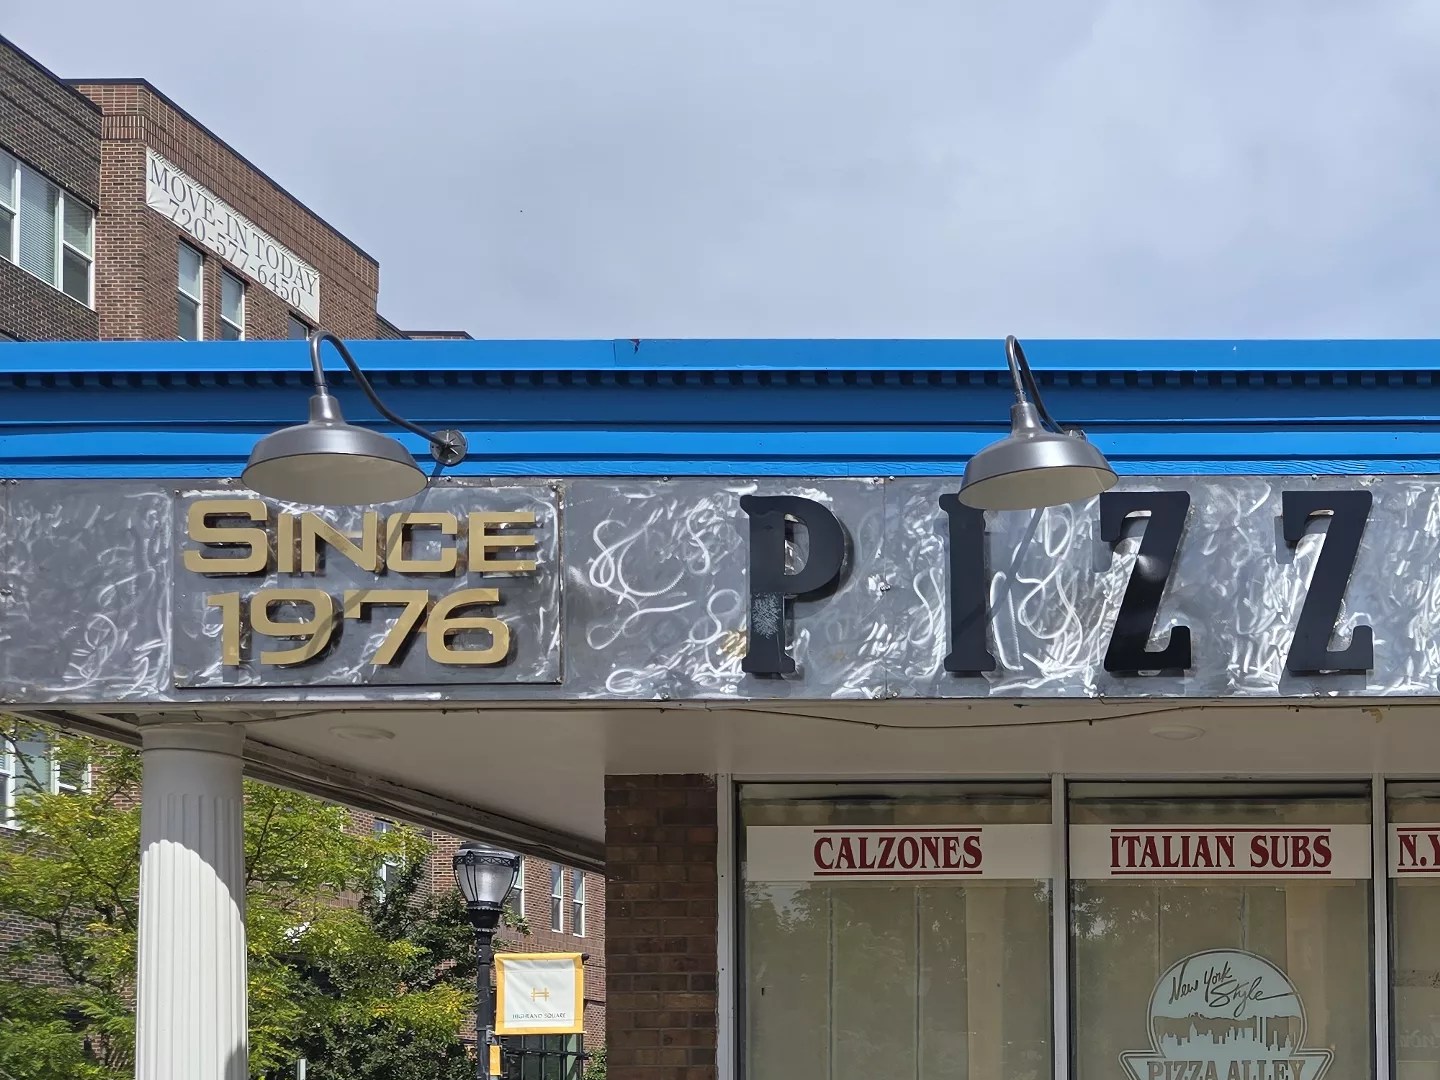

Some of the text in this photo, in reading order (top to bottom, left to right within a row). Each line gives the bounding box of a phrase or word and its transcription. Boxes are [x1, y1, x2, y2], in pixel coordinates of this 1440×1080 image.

[149, 158, 318, 297] MOVE-IN TODAY
[168, 198, 301, 308] 720-577-6450
[183, 499, 537, 574] SINCE
[207, 588, 510, 667] 1976
[813, 835, 983, 869] CALZONES
[1110, 835, 1332, 869] ITALIAN SUBS
[1168, 957, 1232, 1004] New York
[1208, 976, 1298, 1017] Style
